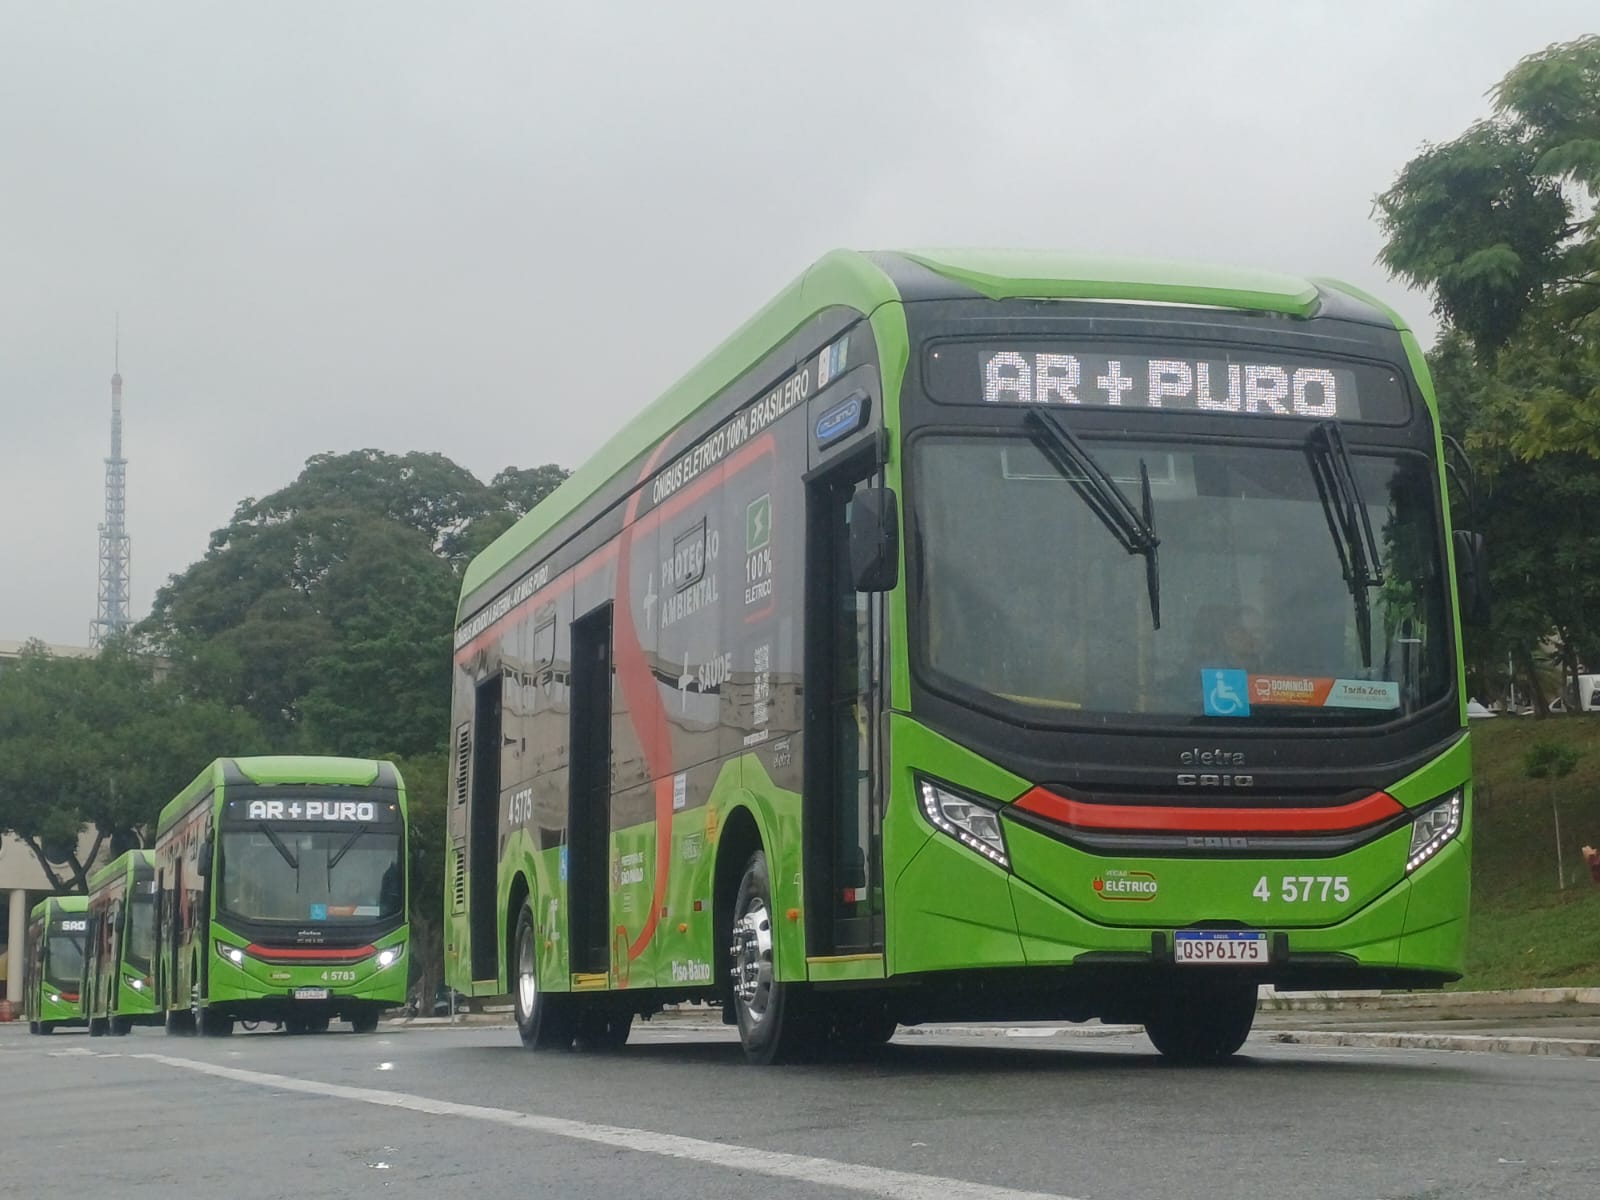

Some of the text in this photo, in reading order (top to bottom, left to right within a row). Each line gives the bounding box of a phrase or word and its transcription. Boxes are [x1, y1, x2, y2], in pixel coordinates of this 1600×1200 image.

[985, 351, 1081, 405] AR
[1147, 359, 1338, 418] PURO
[726, 414, 749, 450] 100%
[750, 368, 809, 436] BRASILEIRO
[745, 546, 772, 583] 100%
[661, 574, 719, 629] AMBIENTAL
[698, 651, 732, 693] SAÚDE
[1368, 687, 1388, 696] Zero
[1180, 748, 1245, 765] eletra
[250, 800, 284, 819] AR
[306, 801, 373, 820] PURO
[514, 788, 533, 824] 5775
[1105, 879, 1157, 893] ELÉTRICO
[1252, 876, 1350, 902] 4 5775
[671, 959, 710, 981] Piso Baixo
